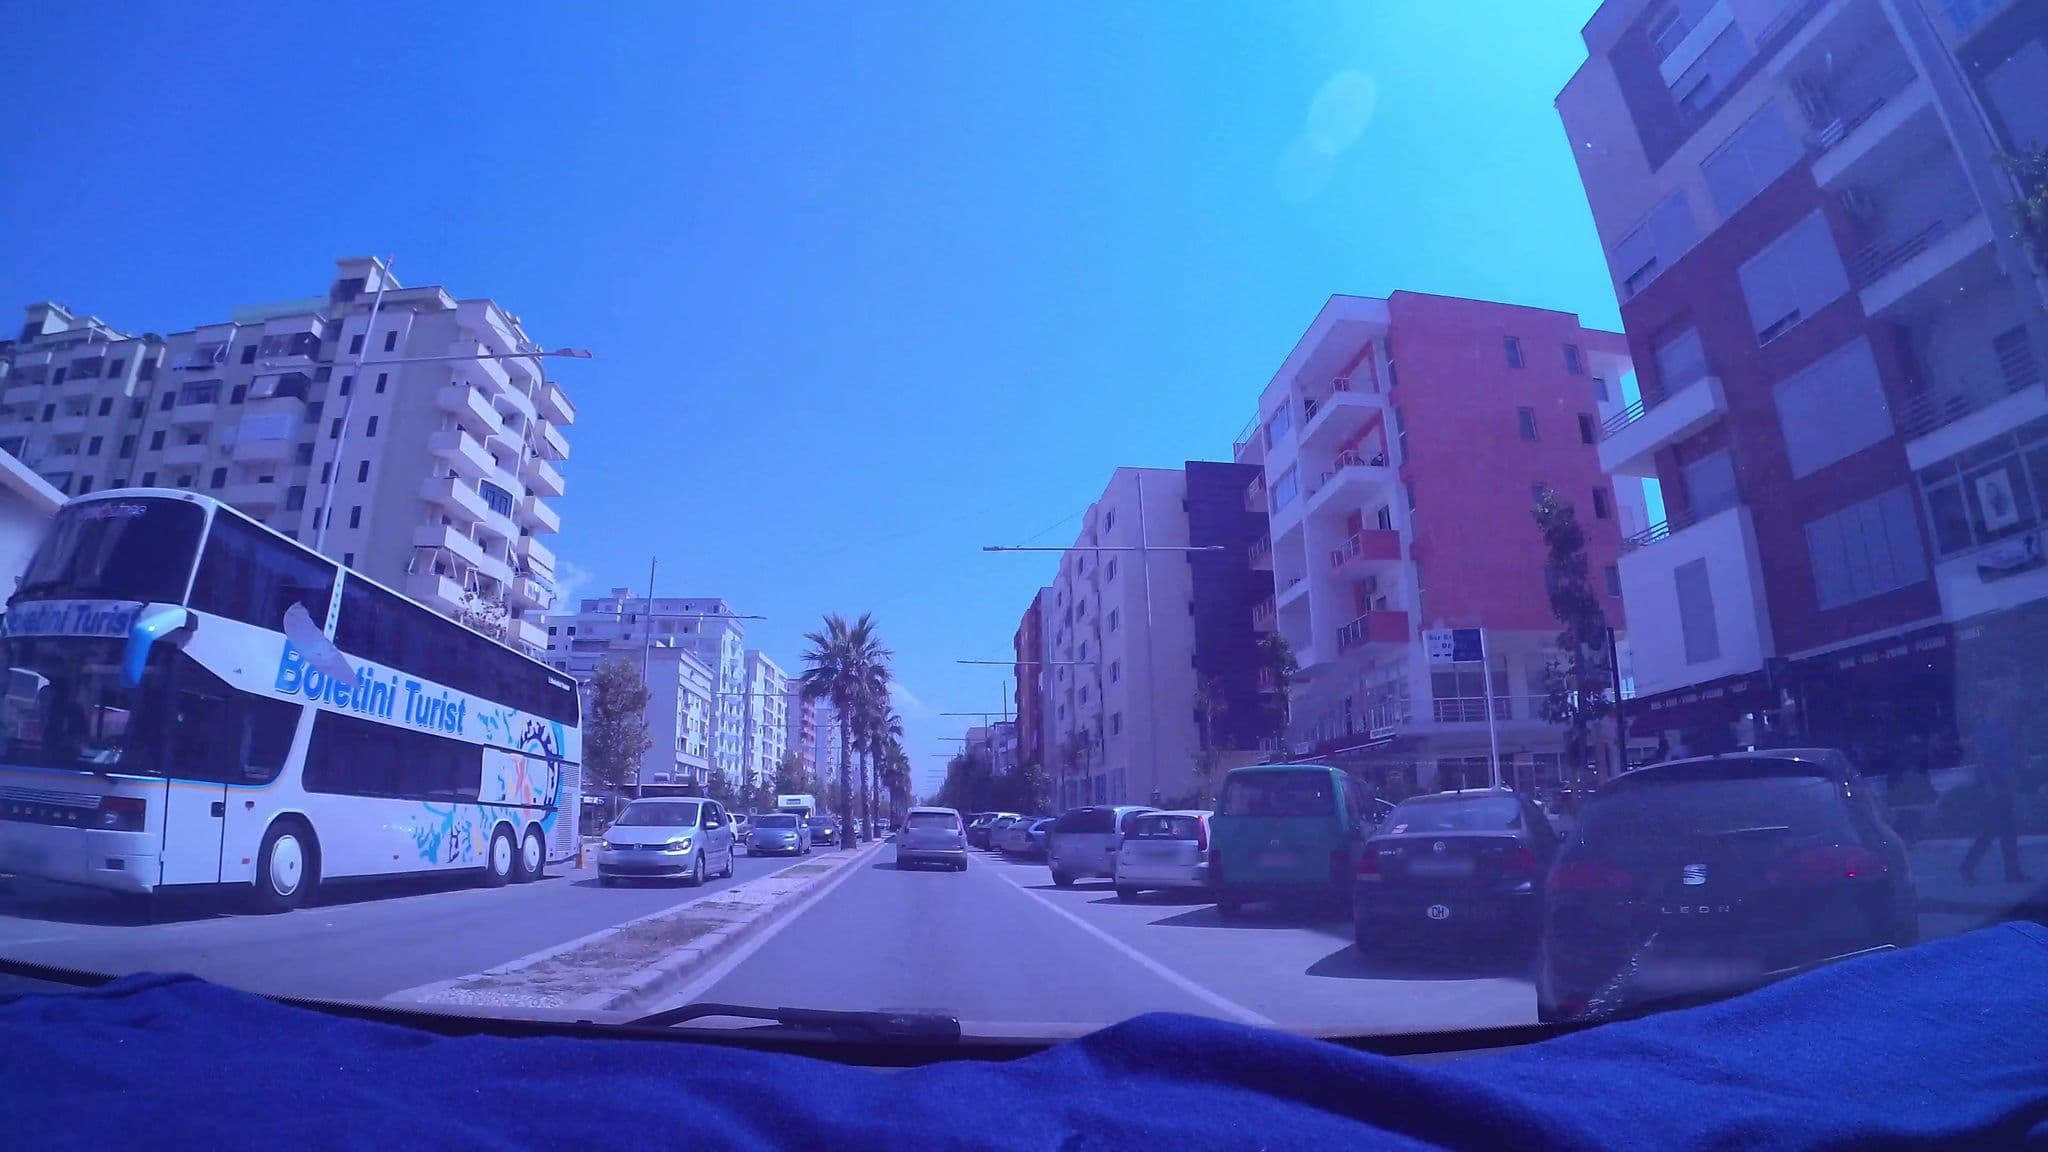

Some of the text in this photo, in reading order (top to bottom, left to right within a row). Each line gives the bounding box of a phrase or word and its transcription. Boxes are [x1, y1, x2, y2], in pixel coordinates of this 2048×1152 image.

[405, 680, 466, 735] Turist
[1431, 906, 1445, 918] CH
[1661, 905, 1730, 914] LEON
